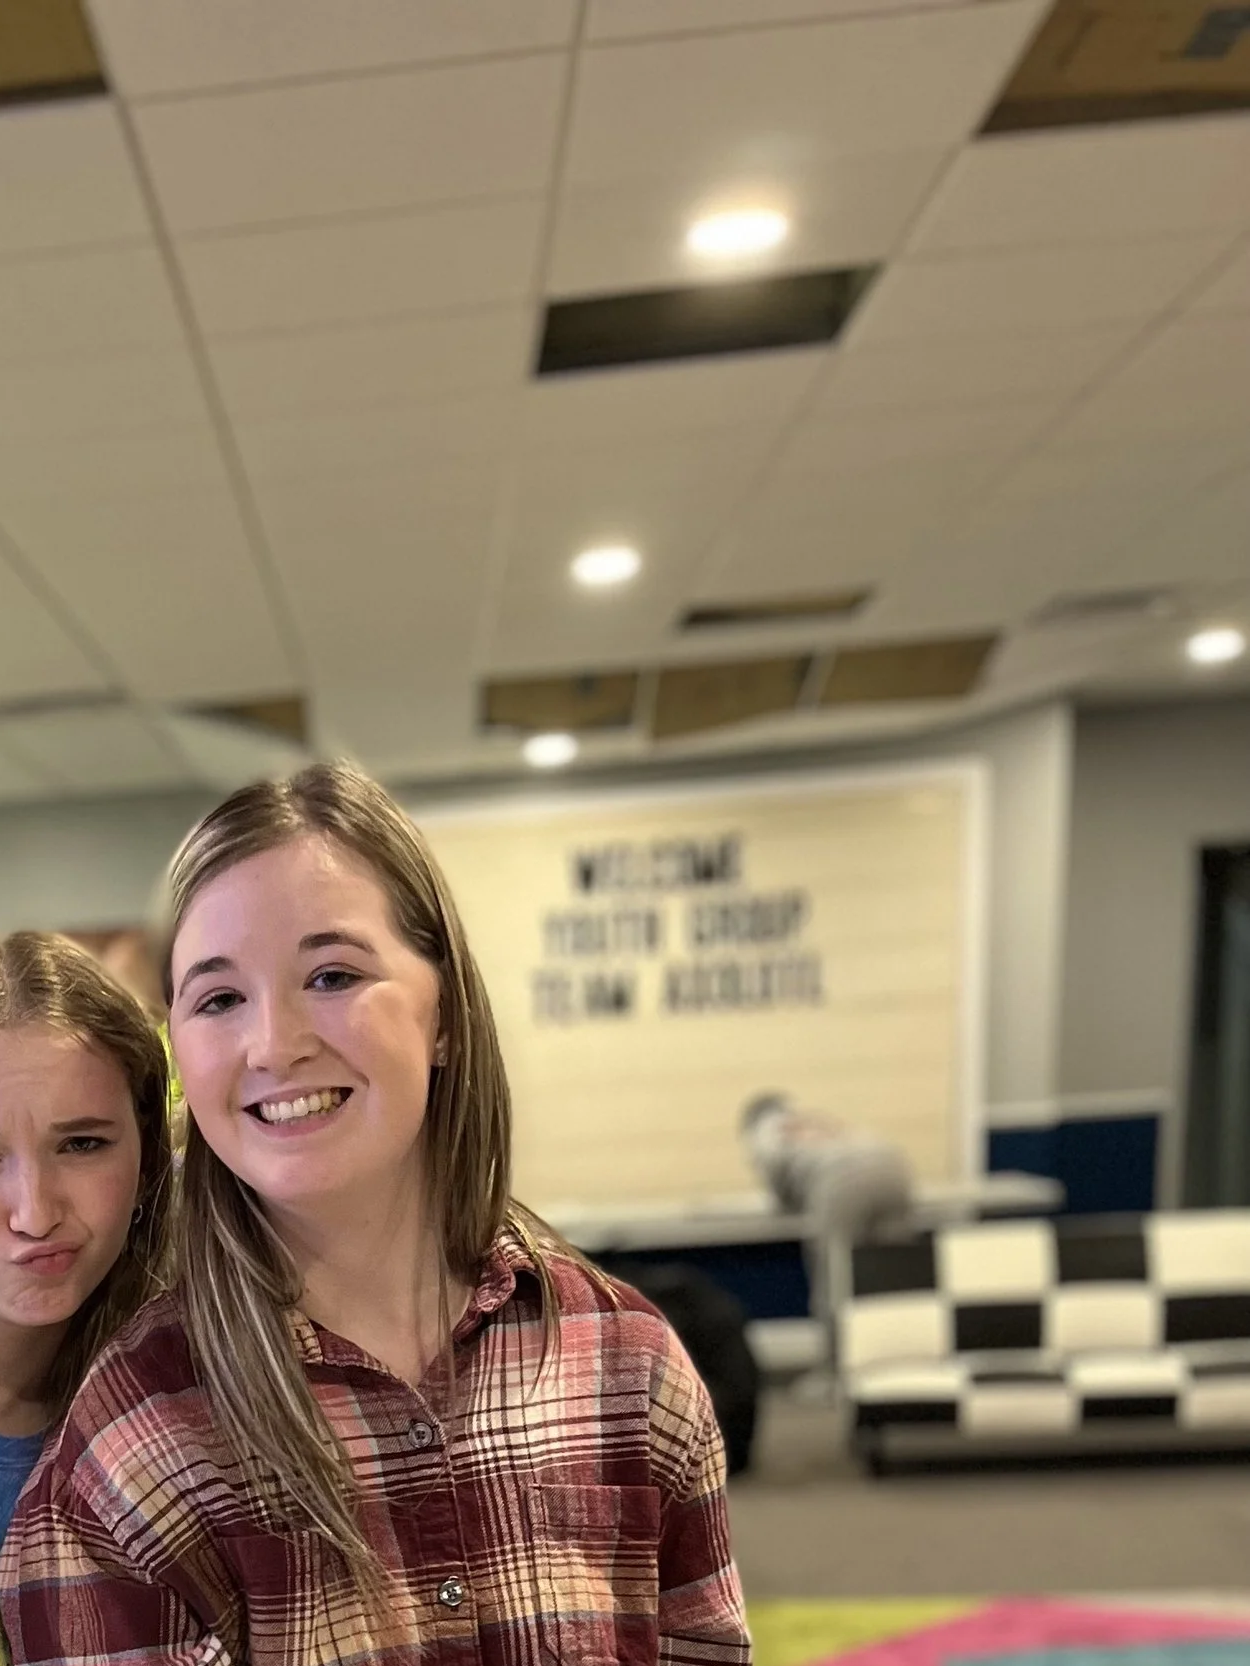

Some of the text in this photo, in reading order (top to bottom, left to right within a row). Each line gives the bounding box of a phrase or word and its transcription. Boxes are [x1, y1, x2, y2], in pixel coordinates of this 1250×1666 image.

[573, 835, 741, 891] WELCOME
[546, 891, 808, 955] YOUTH GROUP
[533, 970, 635, 1026] TEAM
